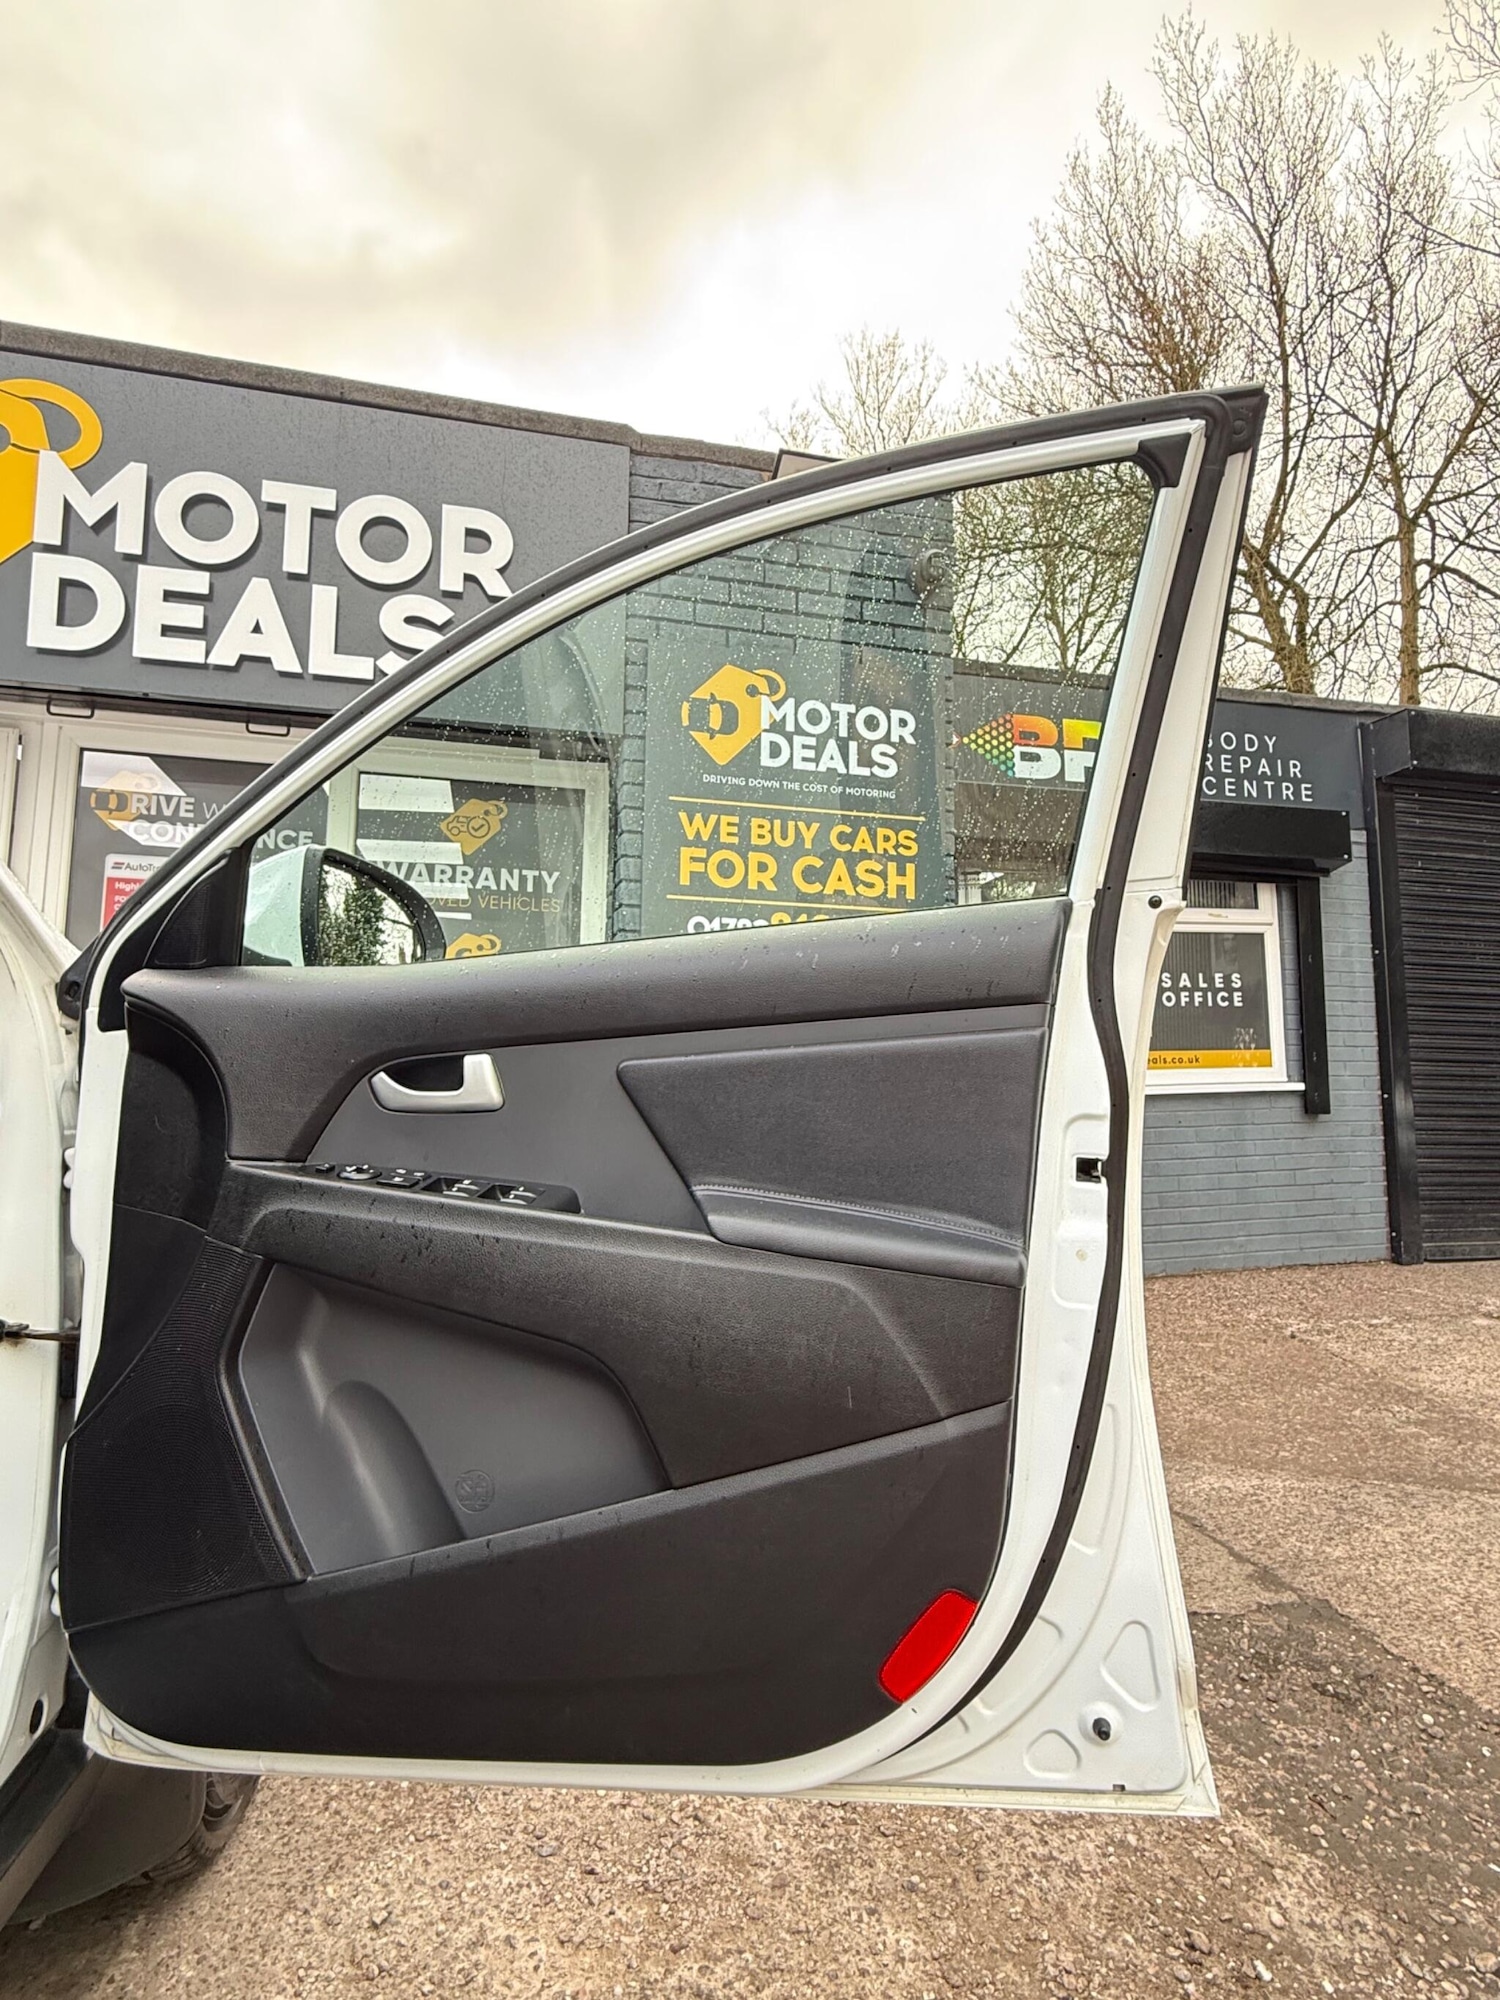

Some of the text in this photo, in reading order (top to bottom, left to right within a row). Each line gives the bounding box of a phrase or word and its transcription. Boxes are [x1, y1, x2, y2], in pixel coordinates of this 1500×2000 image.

[33, 449, 513, 599] MOTOR
[26, 553, 456, 680] DEALS
[761, 694, 917, 745] MOTOR
[760, 732, 899, 779] DEALS
[703, 773, 896, 799] DRIVING DOWN THE COST OF MOTORING
[1202, 776, 1314, 802] CENTRE
[678, 811, 919, 857] WE BUY CARS
[679, 847, 916, 900] FOR CASH
[478, 894, 561, 912] VEHICLES
[1161, 972, 1242, 988] SALES
[1162, 991, 1243, 1007] OFFICE
[1148, 1055, 1200, 1065] als.co.uk
